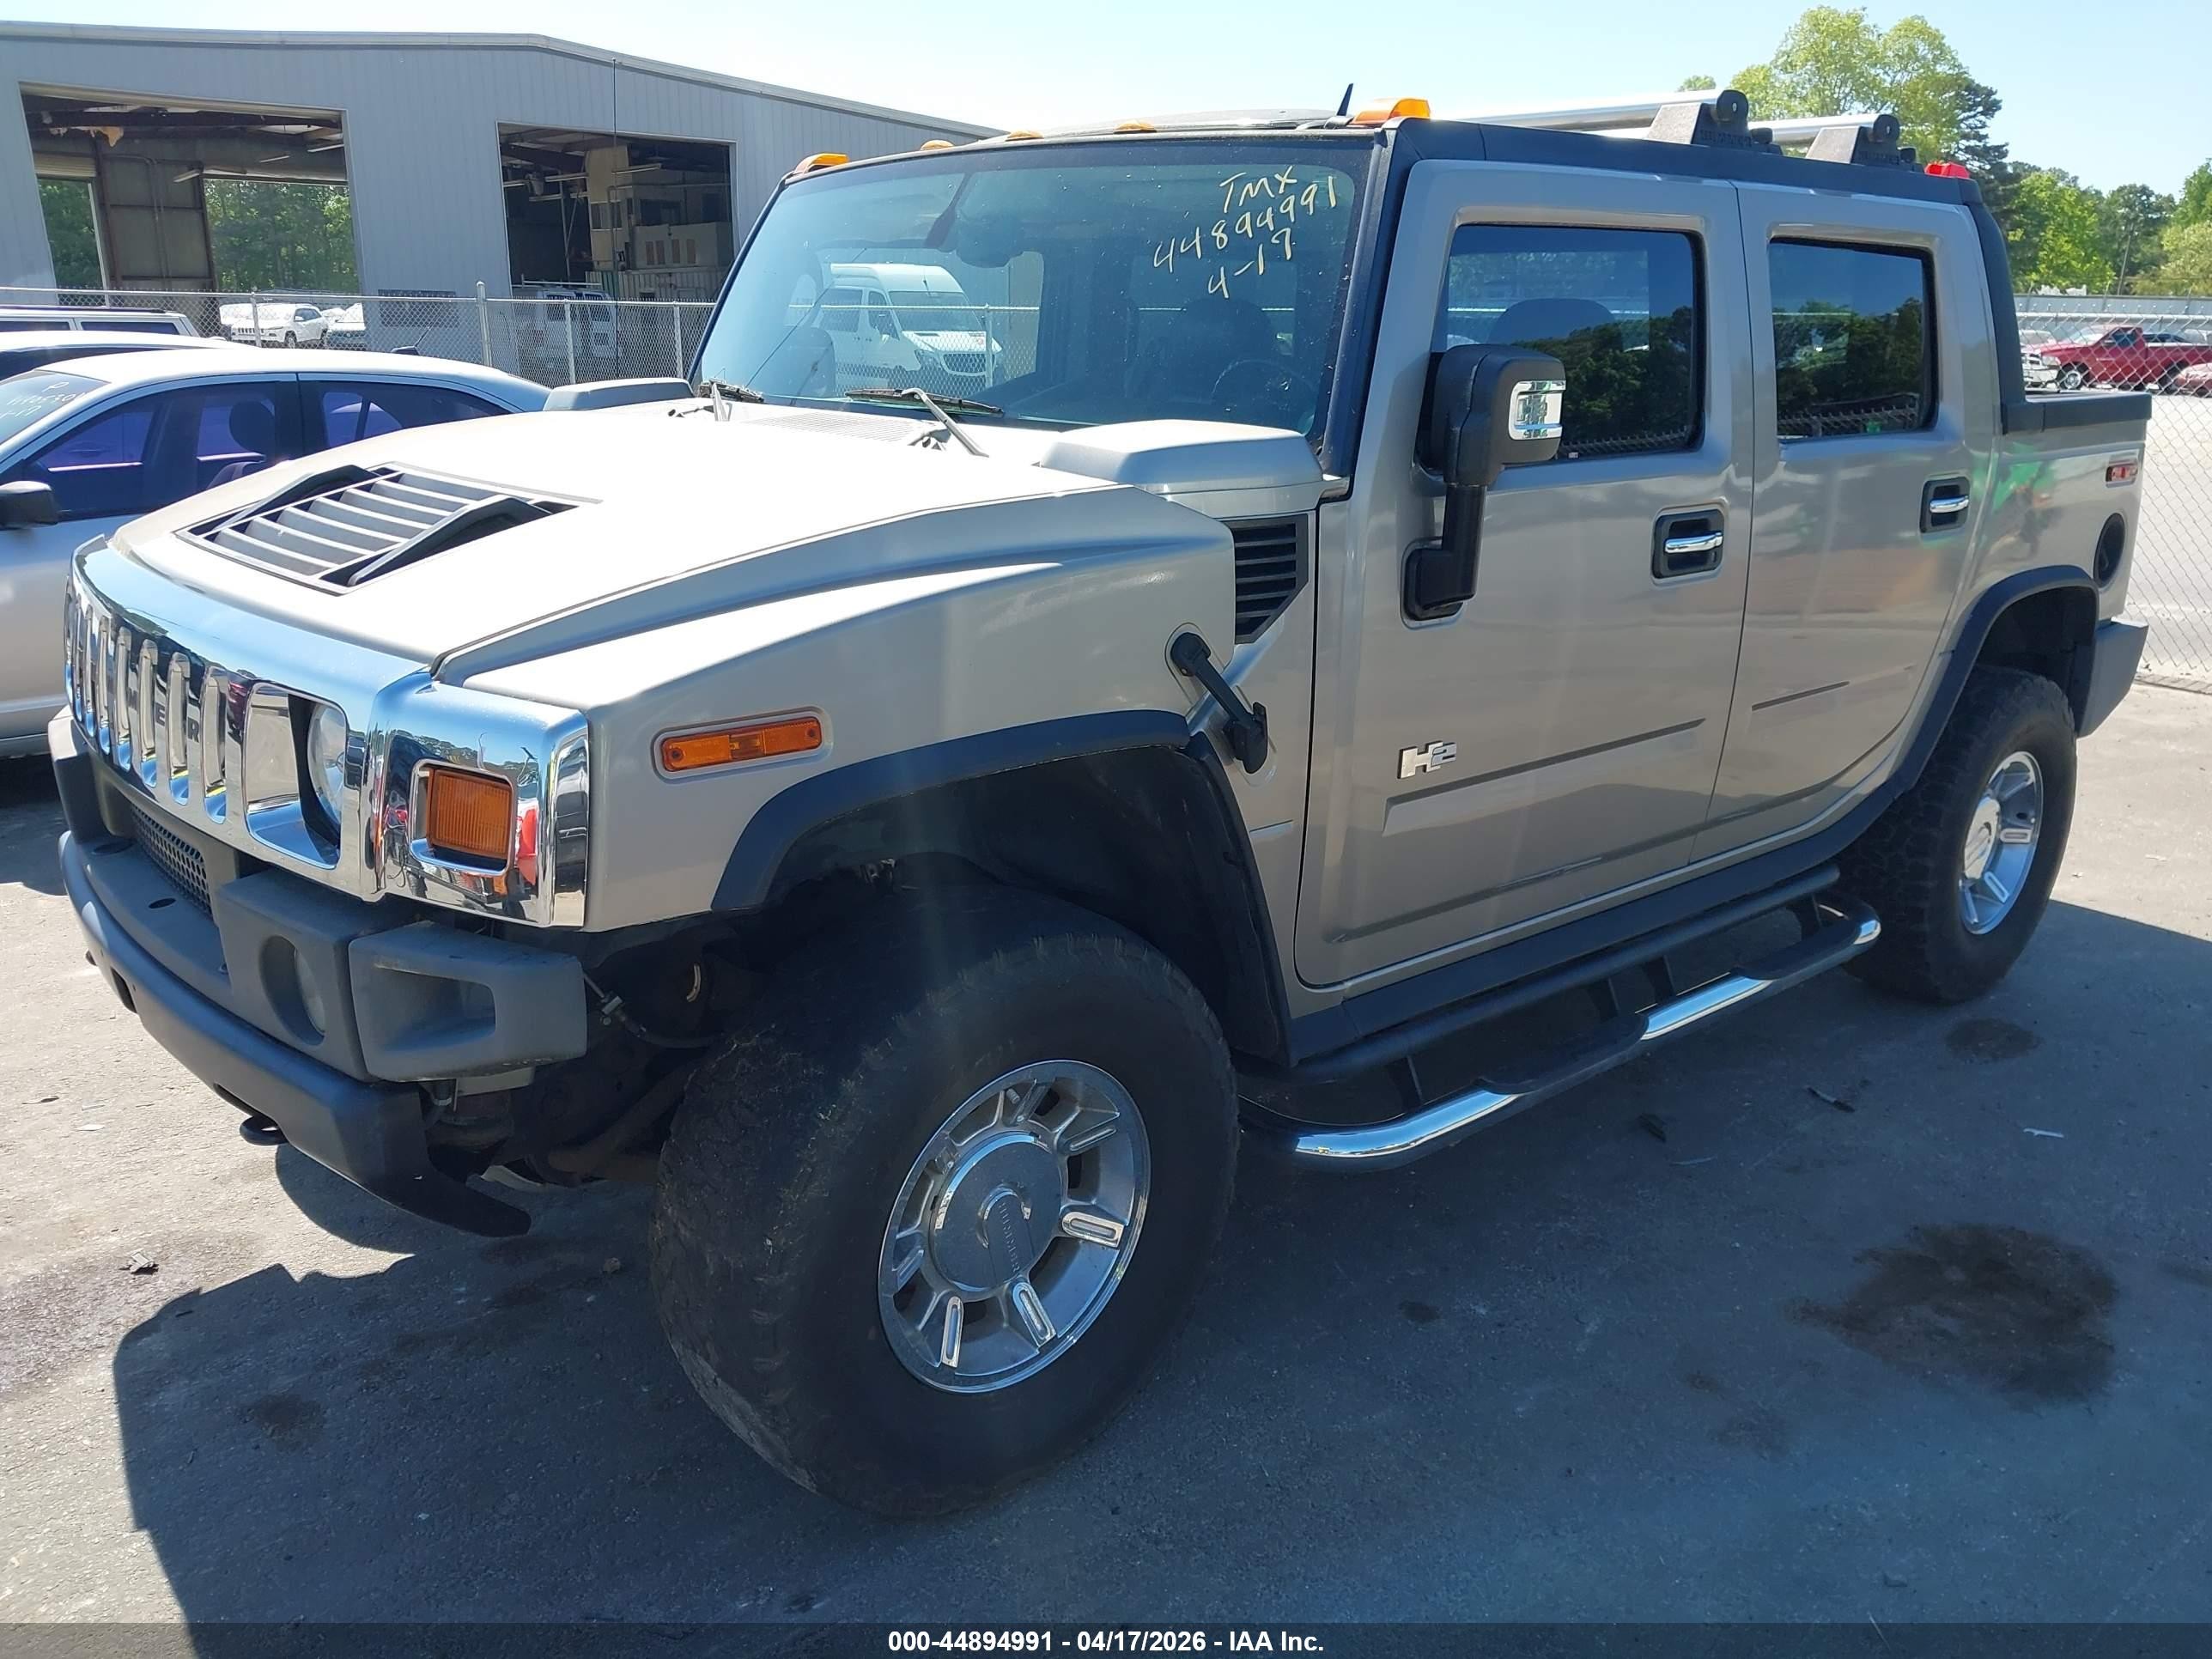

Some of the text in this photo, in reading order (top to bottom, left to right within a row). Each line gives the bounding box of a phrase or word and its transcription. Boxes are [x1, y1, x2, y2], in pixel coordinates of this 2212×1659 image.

[1219, 165, 1298, 214] TMX
[1153, 175, 1337, 273] 44894991
[1207, 227, 1293, 299] 4-17
[1397, 740, 1457, 780] H2
